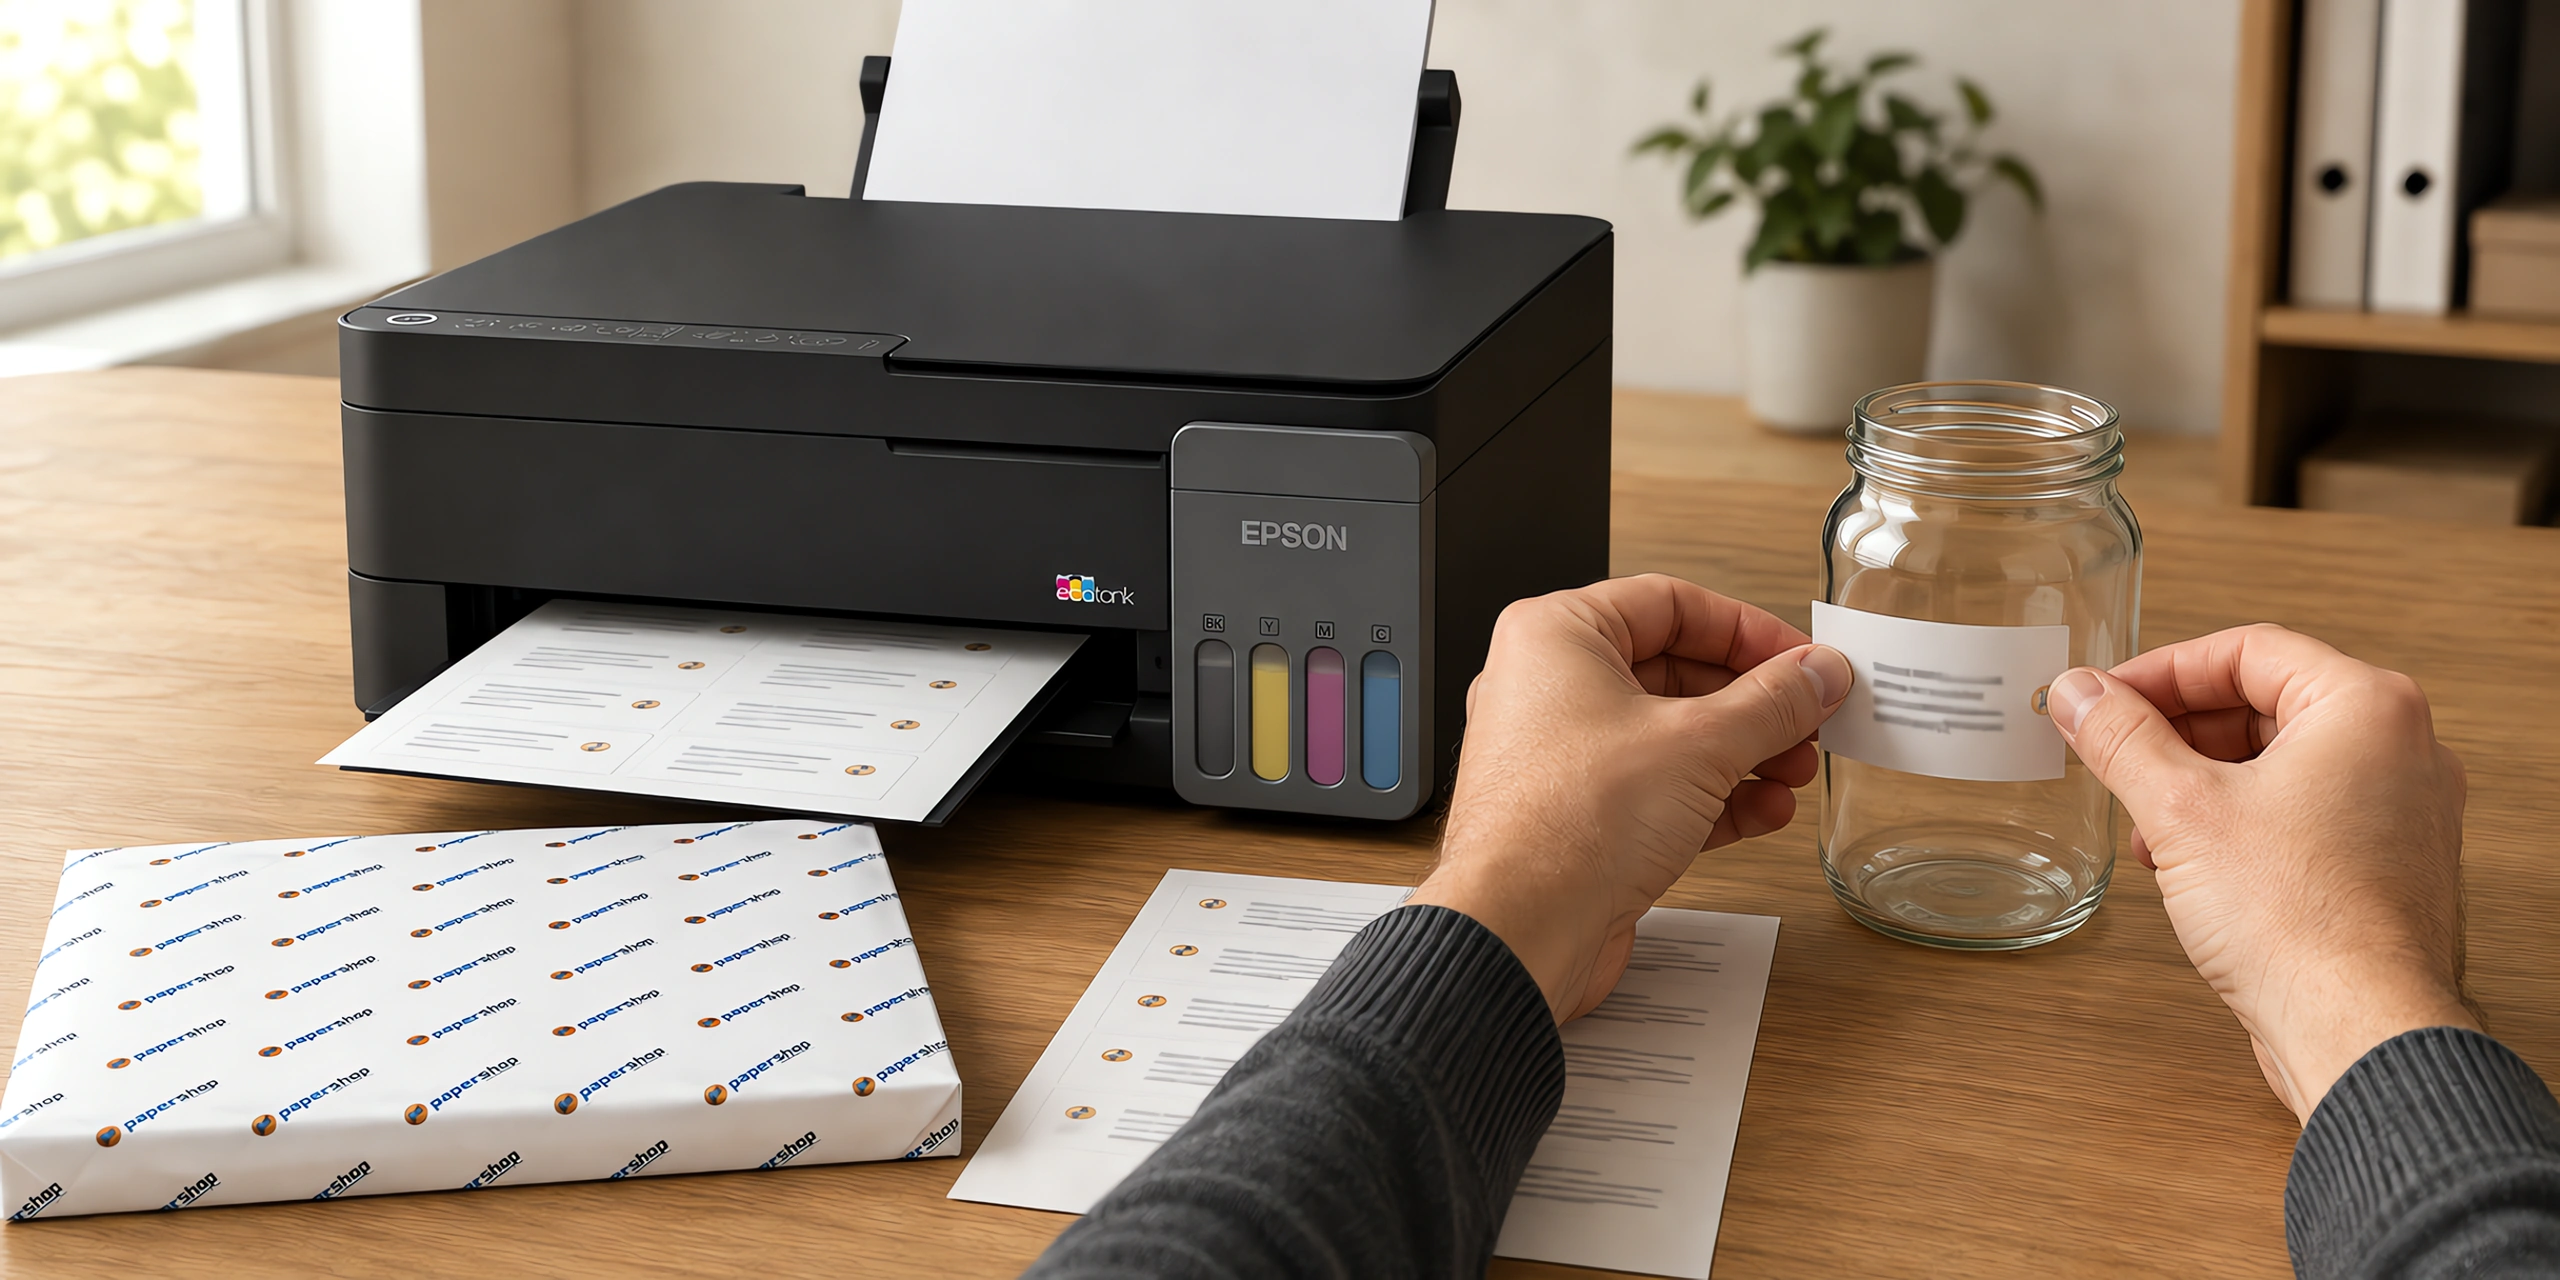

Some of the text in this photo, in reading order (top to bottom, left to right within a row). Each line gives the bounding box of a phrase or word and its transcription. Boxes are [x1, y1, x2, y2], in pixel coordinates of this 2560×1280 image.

[1241, 520, 1347, 551] EPSON
[1205, 617, 1223, 630] BK
[1264, 620, 1275, 632] Y
[1318, 624, 1332, 637] M
[1375, 628, 1388, 640] C
[432, 998, 517, 1038] papershop
[578, 990, 662, 1030] papershop
[721, 984, 800, 1022] papershop
[134, 1019, 226, 1061] papershop
[285, 1009, 372, 1050] papershop
[430, 1058, 520, 1111] papershop
[580, 1048, 668, 1102] papershop
[729, 1041, 811, 1092] papershop
[124, 1080, 218, 1133] papershop
[279, 1068, 370, 1122] papershop
